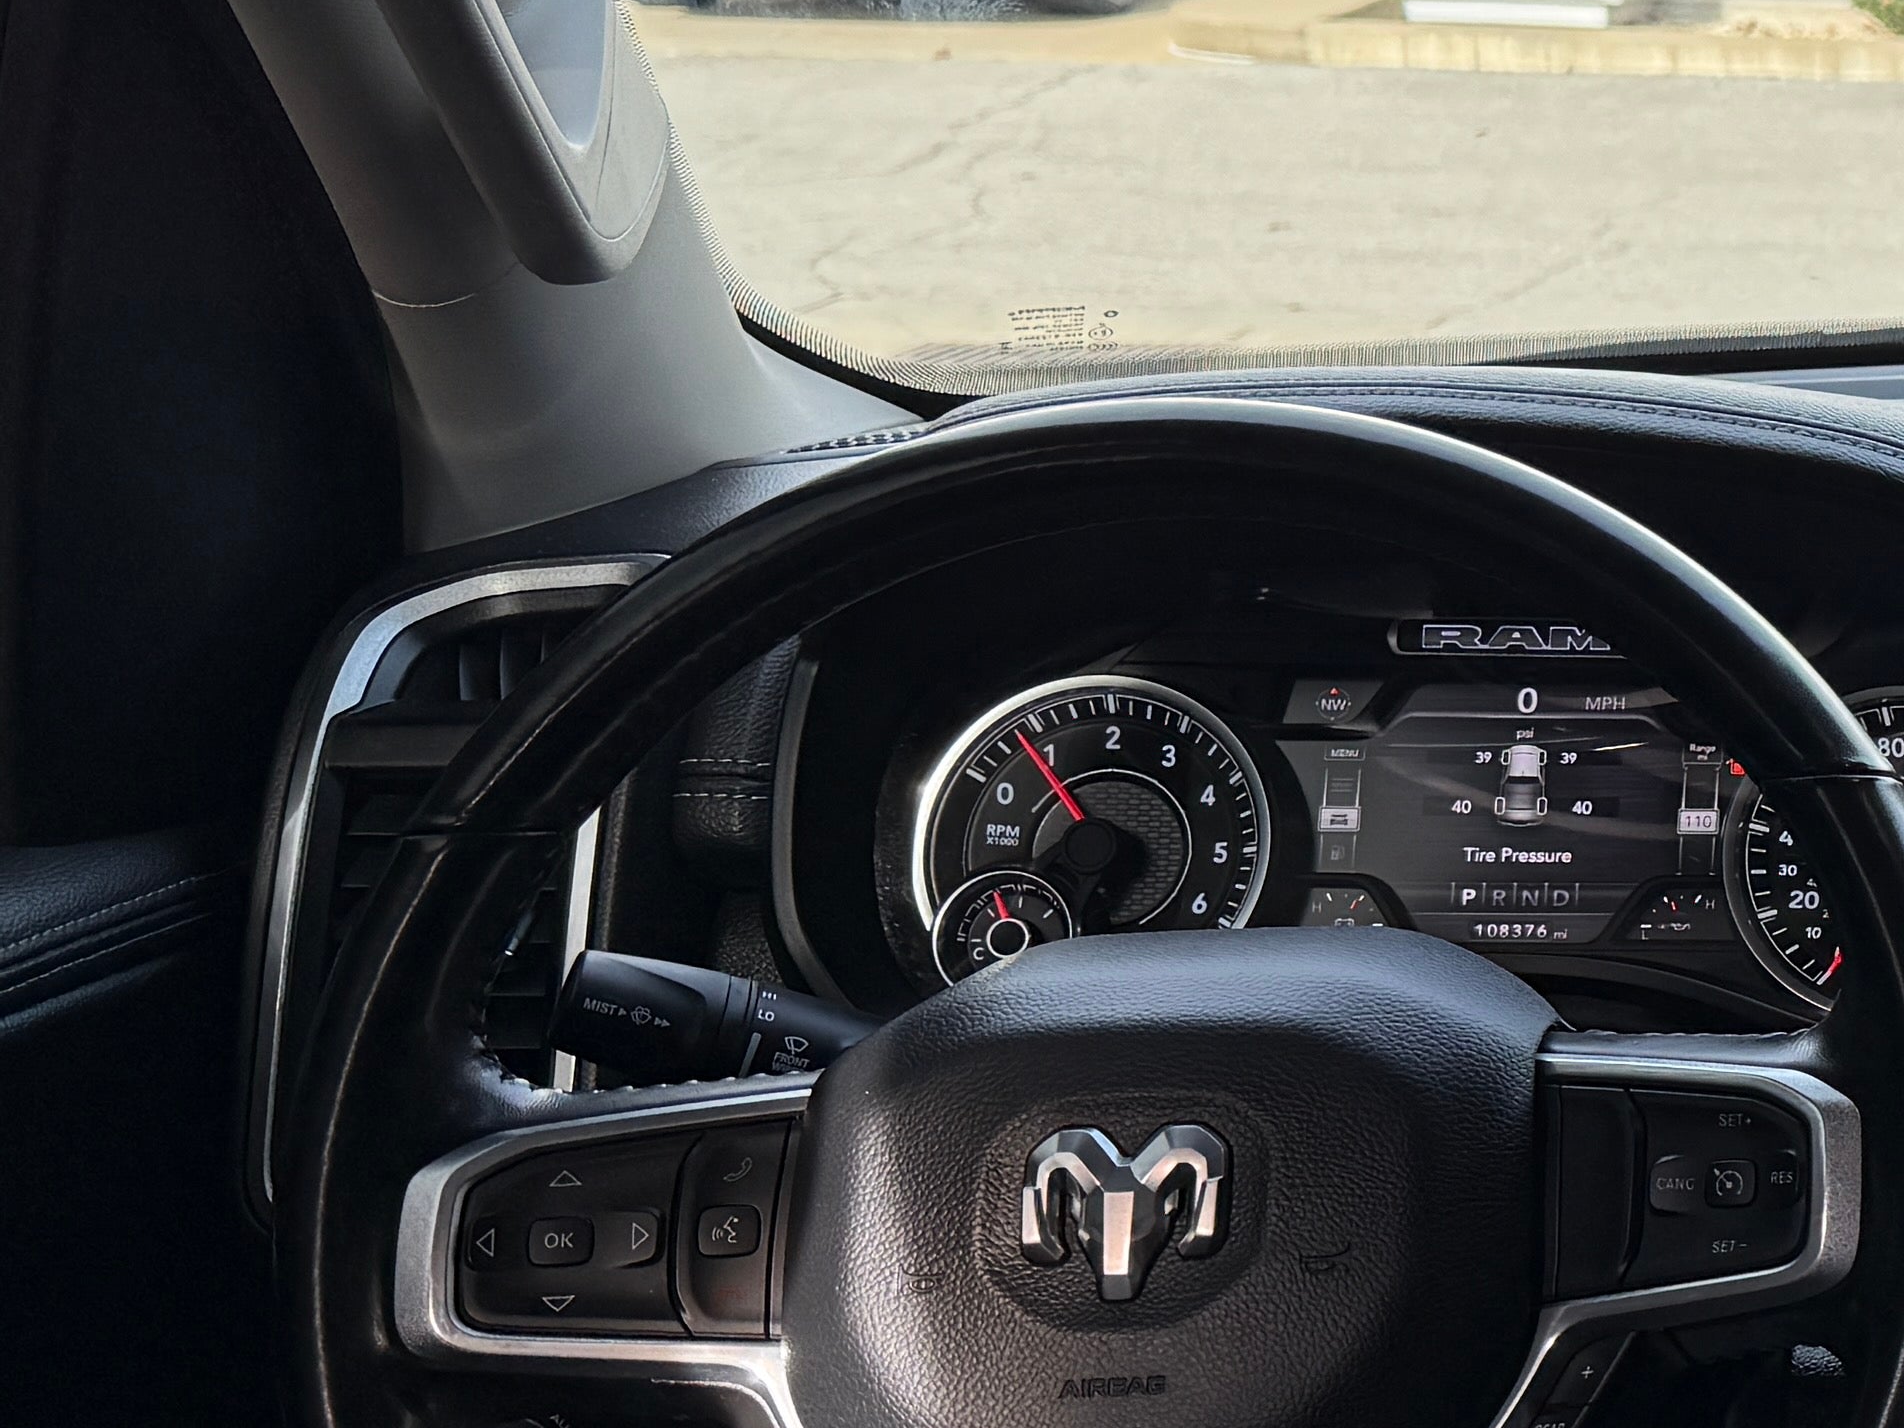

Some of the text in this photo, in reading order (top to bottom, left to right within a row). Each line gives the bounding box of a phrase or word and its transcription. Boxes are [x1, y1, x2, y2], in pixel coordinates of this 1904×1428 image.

[1422, 624, 1612, 651] RAM
[1320, 698, 1347, 711] NW
[1517, 687, 1627, 713] 0 MPH
[1105, 726, 1121, 751] 2
[1516, 728, 1534, 741] psi
[1042, 743, 1055, 767] 1
[1162, 744, 1177, 768] 3
[1475, 751, 1578, 764] 39 39
[1689, 743, 1716, 755] Range
[996, 783, 1015, 805] 0
[1200, 785, 1216, 807] 4
[1451, 800, 1593, 815] 40 40
[1684, 815, 1712, 828] 110
[985, 823, 1020, 838] RPM
[1213, 841, 1228, 864] 5
[1463, 848, 1573, 864] Tire Pressure
[1778, 863, 1797, 877] 30
[1191, 892, 1208, 915] 6
[1461, 889, 1570, 907] P R N D
[1788, 891, 1820, 910] 20
[1474, 924, 1568, 940] 108376 mi
[1805, 926, 1822, 940] 10
[973, 947, 985, 961] C
[582, 997, 618, 1016] MIST
[1770, 1171, 1793, 1185] RES
[544, 1232, 574, 1249] OK
[1058, 1375, 1165, 1398] AIRBAG
